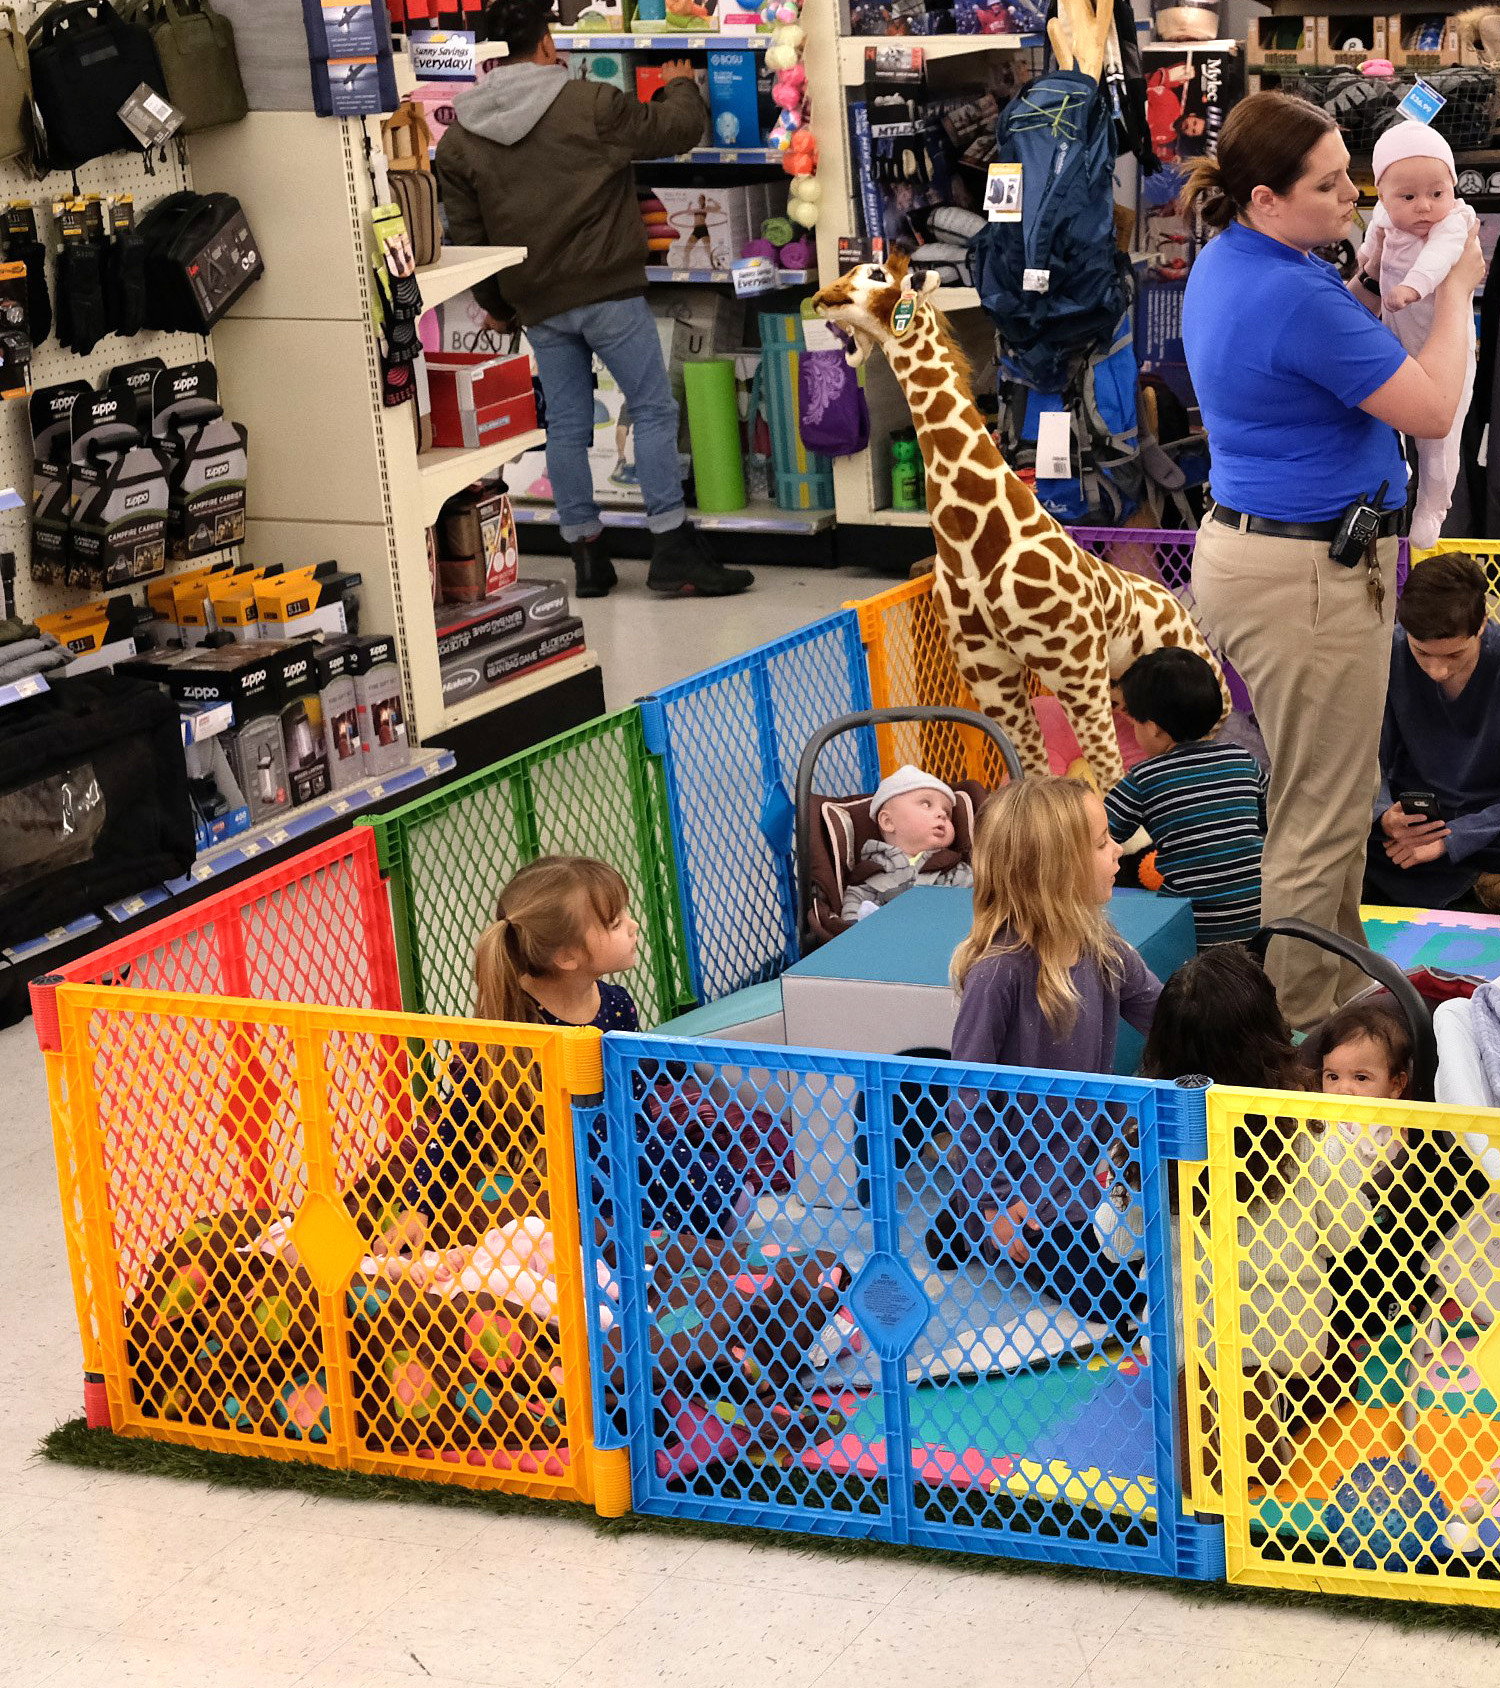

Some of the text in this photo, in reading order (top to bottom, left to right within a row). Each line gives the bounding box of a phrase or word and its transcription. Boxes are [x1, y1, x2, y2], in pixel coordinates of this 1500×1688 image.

[415, 47, 469, 57] Sunny Savings
[415, 58, 473, 71] Everyday!
[1204, 58, 1222, 103] Mylec
[452, 331, 503, 350] BOSU
[241, 669, 267, 689] Zippo
[283, 660, 307, 679] Zippo
[183, 684, 220, 701] Zippo
